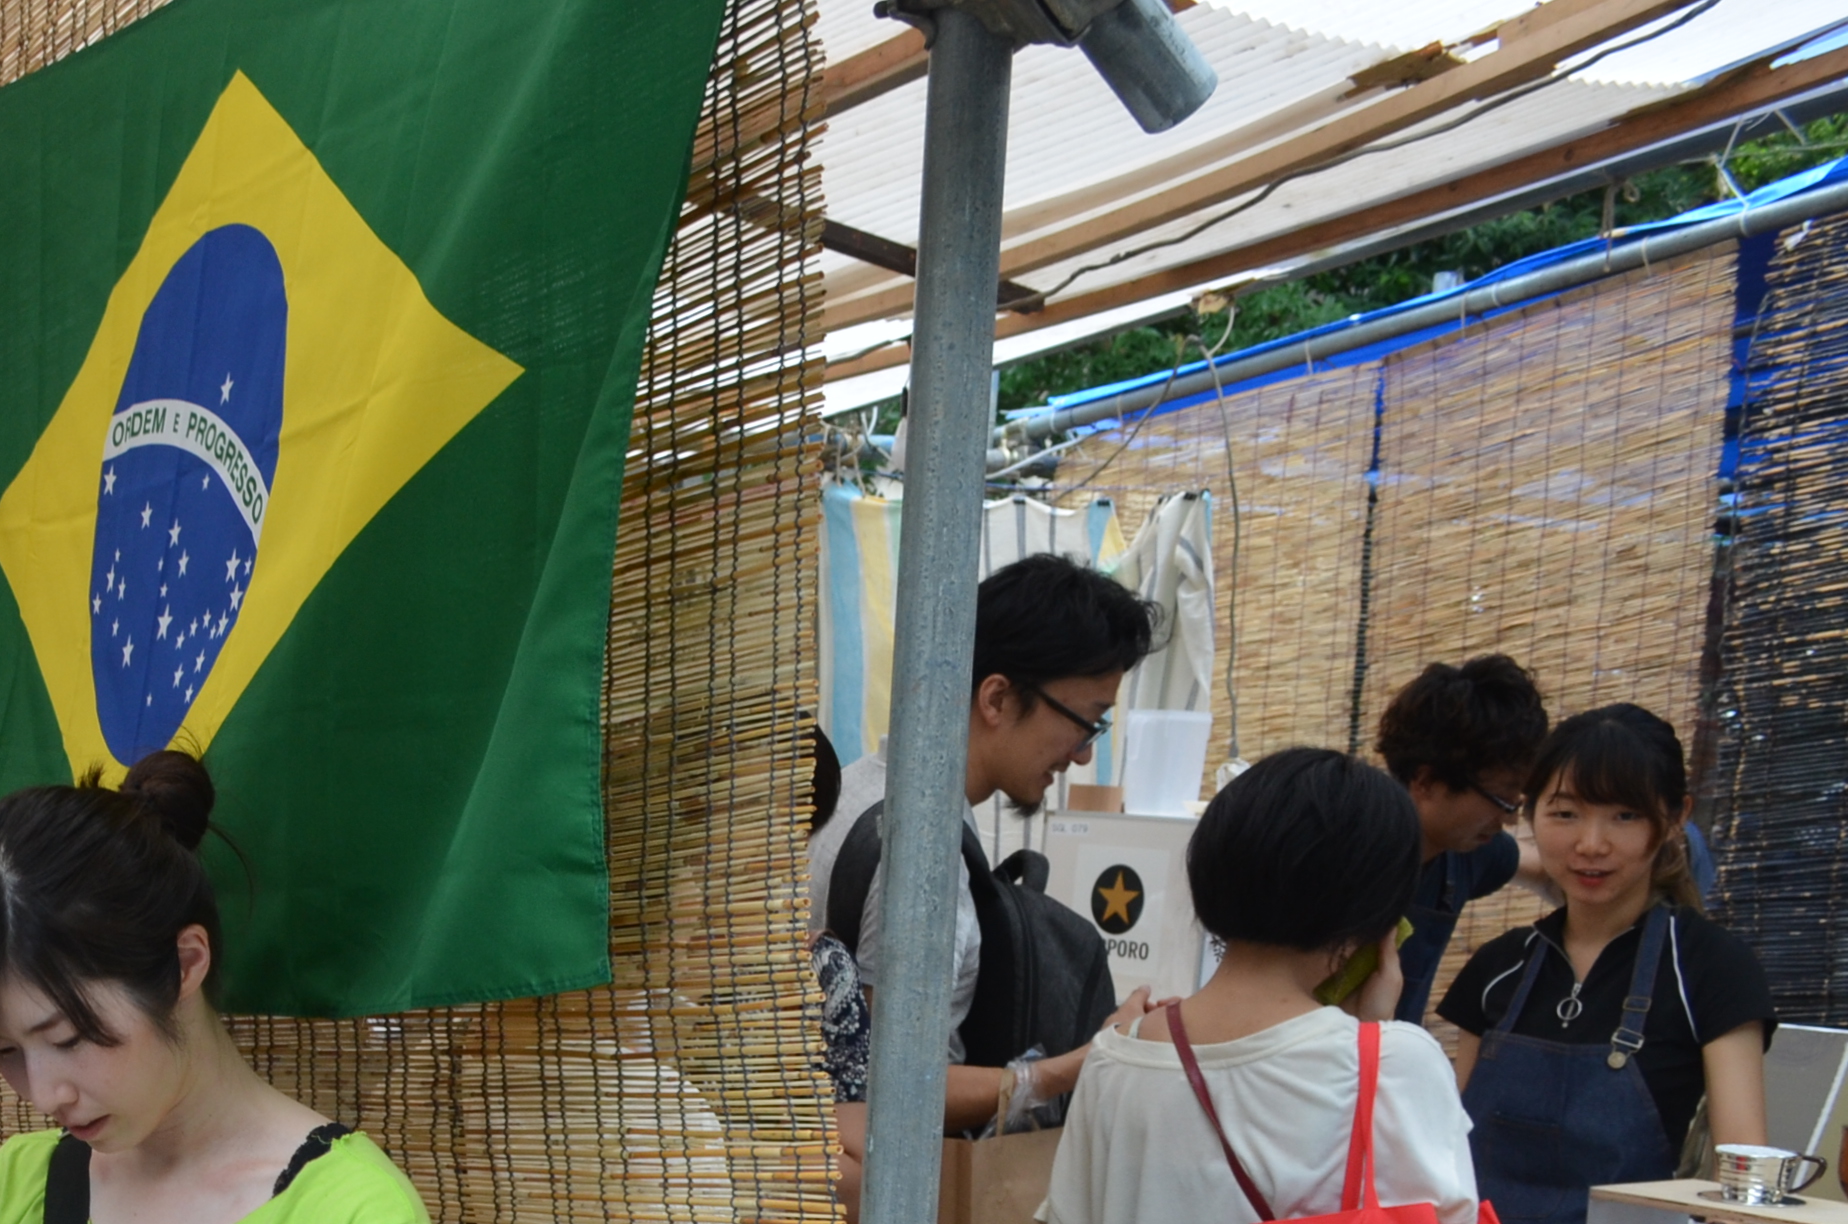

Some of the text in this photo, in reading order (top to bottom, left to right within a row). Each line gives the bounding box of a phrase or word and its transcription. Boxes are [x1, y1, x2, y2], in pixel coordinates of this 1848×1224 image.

[112, 407, 264, 525] ORDEM E PROGRESSO
[1103, 939, 1149, 960] PORO
